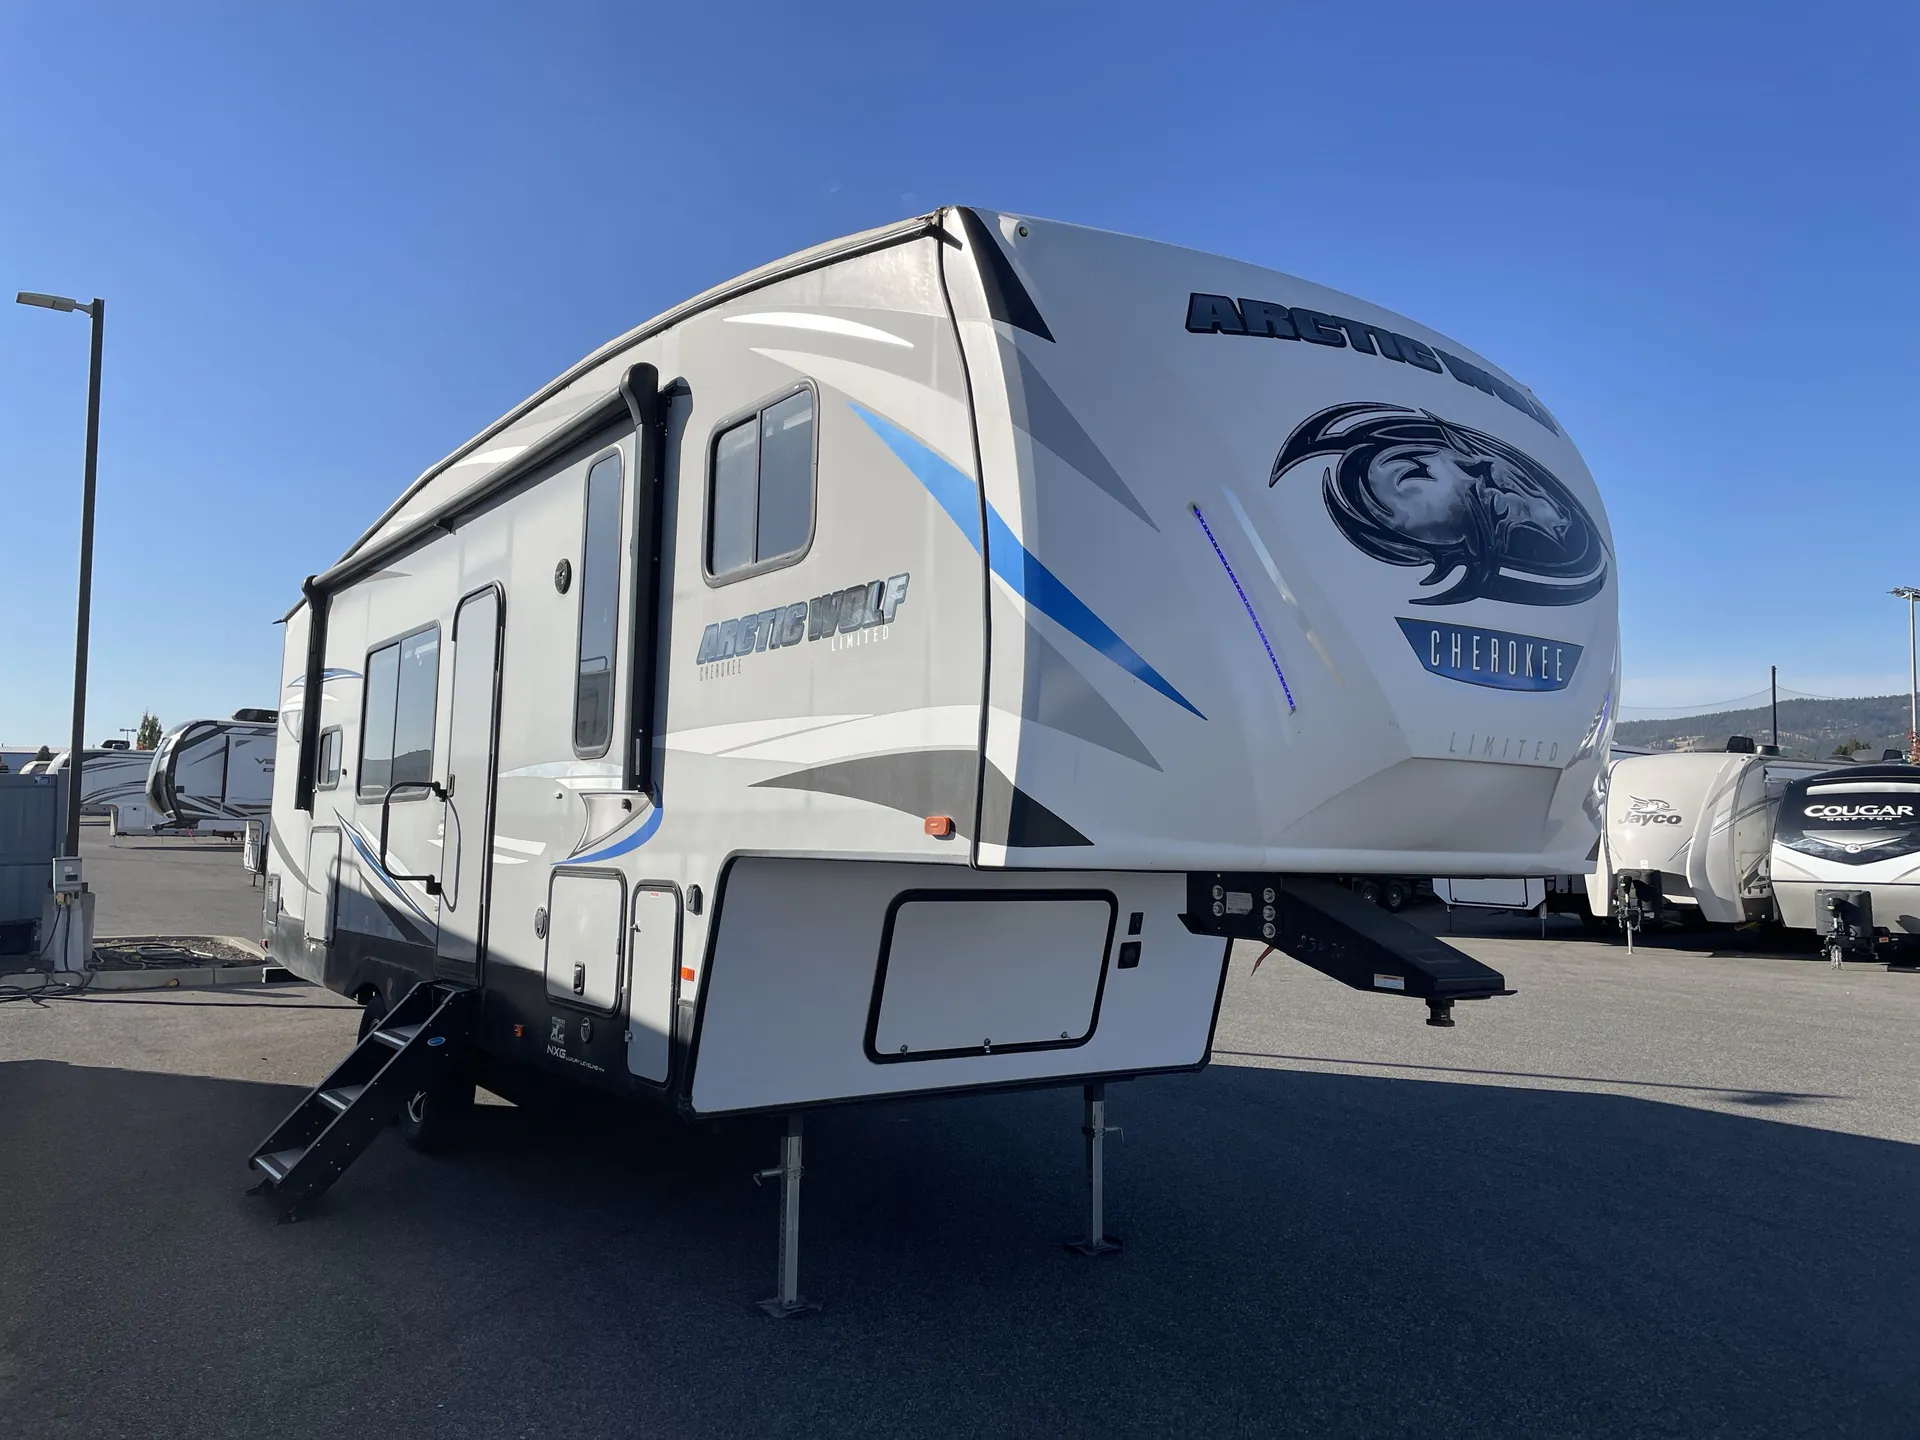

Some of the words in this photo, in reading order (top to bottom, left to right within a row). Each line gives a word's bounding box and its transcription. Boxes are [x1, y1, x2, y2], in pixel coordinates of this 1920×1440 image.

[1186, 292, 1443, 374] ARCTIC
[696, 601, 808, 665] ARCTIC
[808, 572, 910, 642] WOLF
[831, 625, 889, 651] LIMITED
[1430, 630, 1563, 682] CHEROKEE
[1449, 732, 1559, 762] LIMITED
[1617, 811, 1682, 826] Jayco
[1804, 804, 1915, 817] COUGAR
[547, 1044, 566, 1059] NXG
